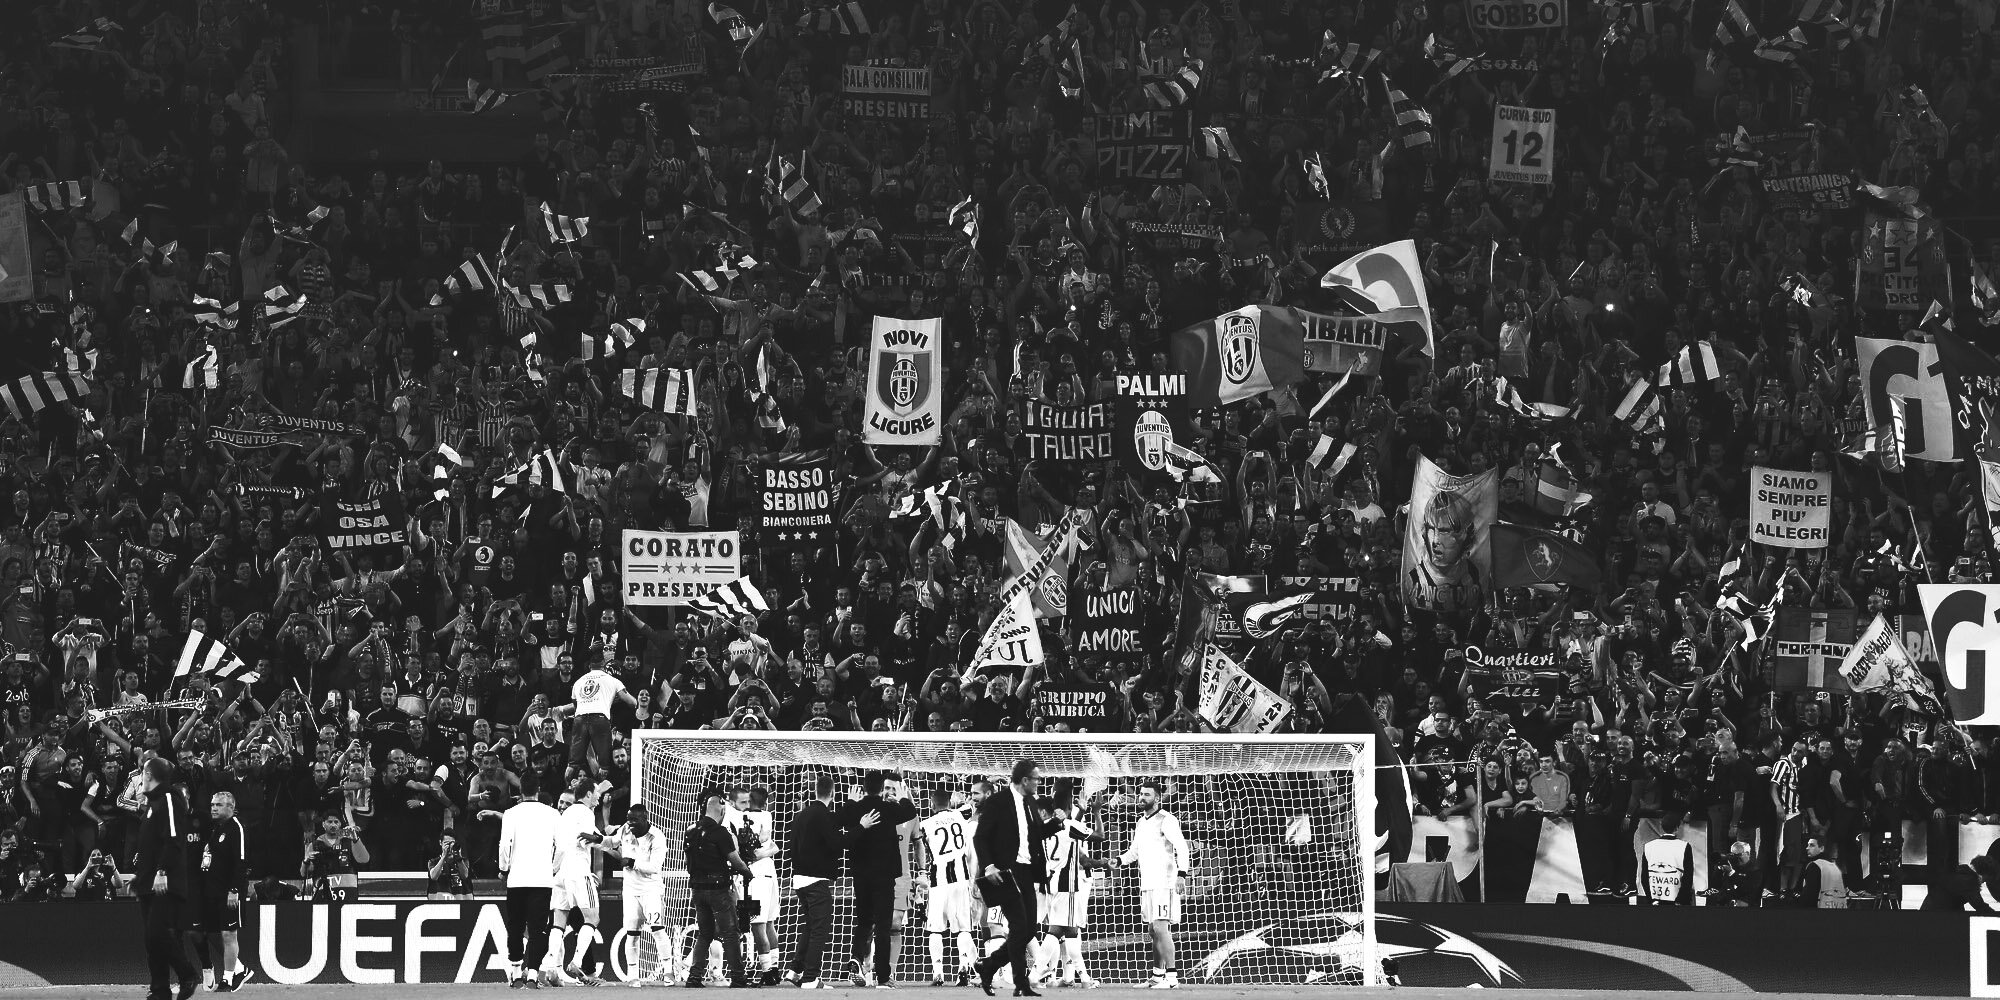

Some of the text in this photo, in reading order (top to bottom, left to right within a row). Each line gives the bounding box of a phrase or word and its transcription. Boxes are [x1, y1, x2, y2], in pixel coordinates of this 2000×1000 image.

[1473, 2, 1559, 26] GOBBO
[843, 69, 930, 91] SALA CONSILINA
[843, 99, 929, 118] PRESENTE
[1499, 107, 1552, 124] CURVA SUD
[1096, 111, 1174, 142] COME
[1503, 130, 1544, 167] 12
[1493, 171, 1548, 182] JUVENTUS 1897
[1884, 246, 1919, 273] 34
[883, 330, 929, 350] NOVI
[892, 370, 917, 378] JUVENTUS
[1115, 374, 1186, 396] PALMI
[277, 415, 345, 432] JUVENTUS
[869, 411, 936, 436] LIGURE
[1136, 424, 1170, 433] JUVENTUS
[211, 429, 279, 445] JUVENTUS
[1025, 432, 1112, 460] TAURO
[766, 467, 824, 489] BASSO
[1762, 474, 1819, 491] SIAMO
[763, 489, 829, 511] SEBINO
[1758, 489, 1828, 507] SEMPRE
[339, 514, 390, 529] OSA
[762, 514, 832, 527] BIANCONERA
[1771, 508, 1807, 523] PIU'
[327, 530, 405, 548] VINCE
[1755, 522, 1828, 540] ALLEGRI
[629, 538, 734, 558] CORATO
[628, 582, 727, 598] PRESENT
[1078, 627, 1144, 652] AMORE
[1465, 645, 1556, 668] Quartieri
[1778, 642, 1852, 658] TORTONA
[1038, 691, 1107, 705] GRUPPO
[1040, 704, 1106, 717] SAMBUCA
[934, 822, 965, 856] 28
[326, 875, 344, 888] TV
[1158, 904, 1169, 918] 15
